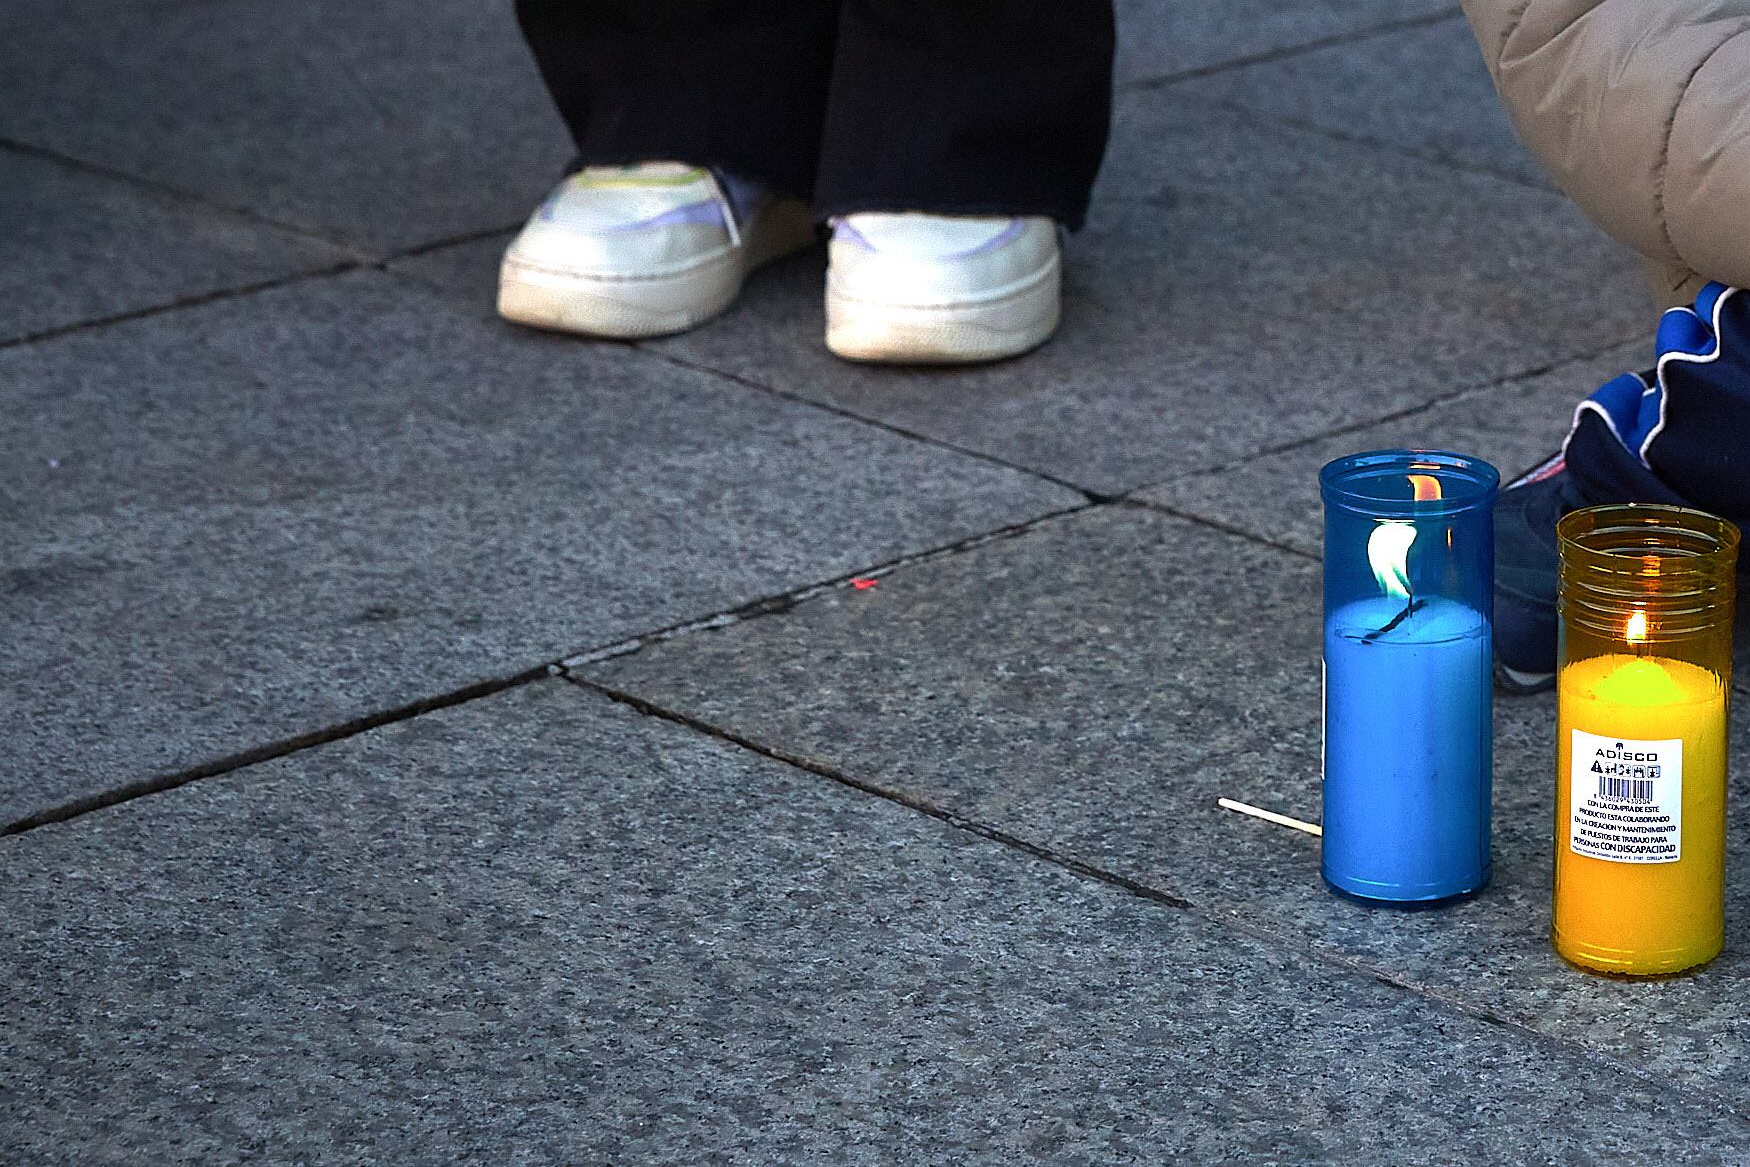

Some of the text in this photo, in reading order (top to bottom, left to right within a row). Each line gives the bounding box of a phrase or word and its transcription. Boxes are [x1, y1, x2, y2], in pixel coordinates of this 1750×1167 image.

[1587, 799, 1599, 808] CON
[1607, 803, 1634, 812] COMPRA
[1579, 807, 1607, 819] PRODUCTO
[1622, 815, 1670, 823] COLABORANDO
[1580, 828, 1587, 836] DE
[1587, 830, 1612, 841] PUESTOS
[1621, 836, 1650, 844] TRABAJO
[1650, 836, 1668, 844] PARA
[1622, 825, 1676, 833] MANTENIMIENTO
[1573, 836, 1600, 849] PERSONAS
[1600, 841, 1616, 852] CON
[1617, 844, 1676, 854] DISCAPACIDAD
